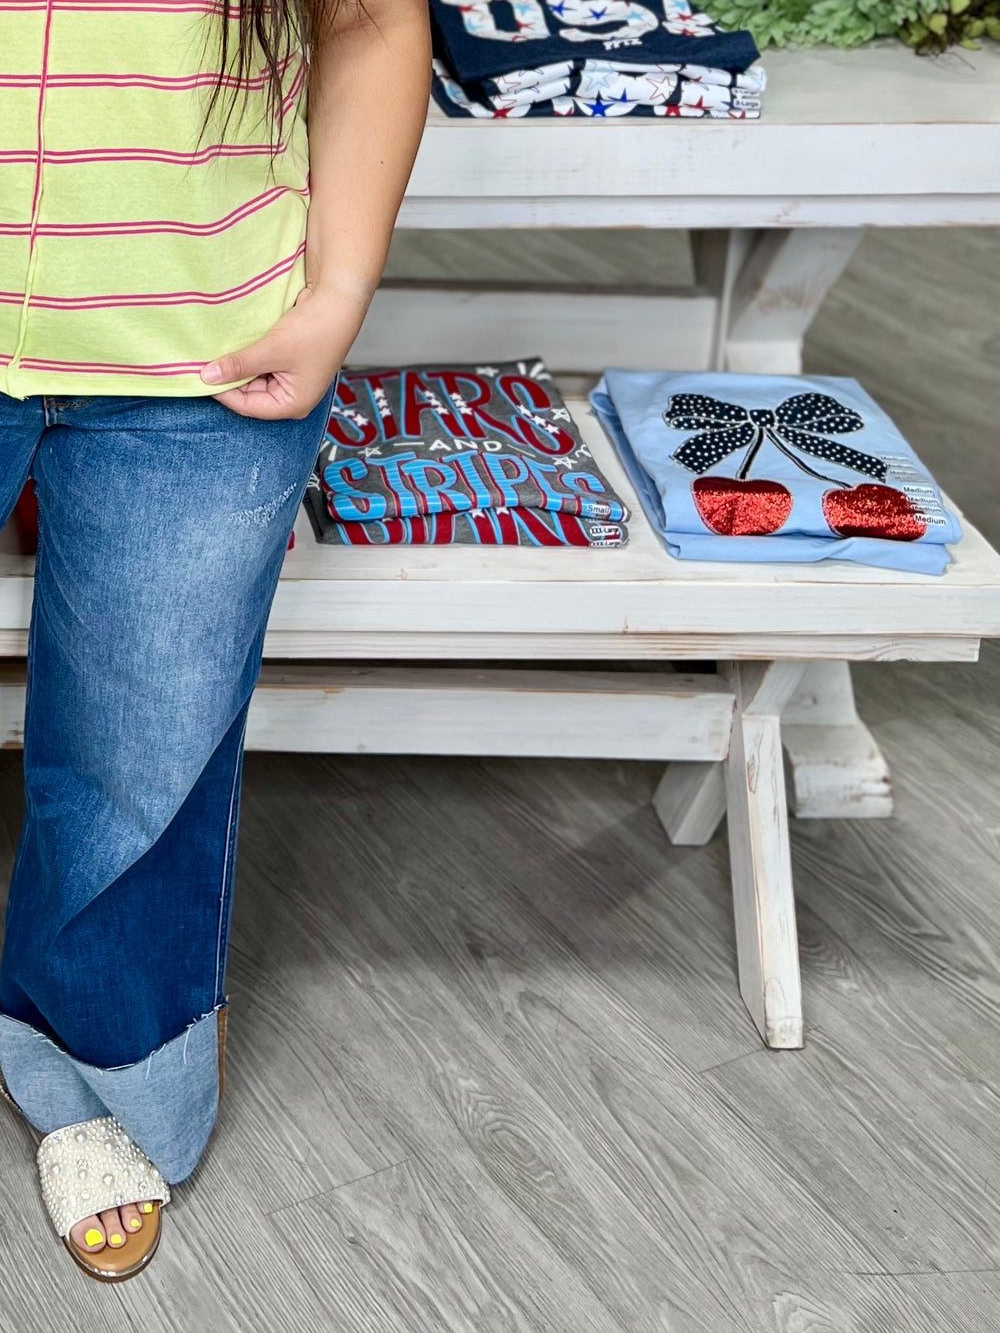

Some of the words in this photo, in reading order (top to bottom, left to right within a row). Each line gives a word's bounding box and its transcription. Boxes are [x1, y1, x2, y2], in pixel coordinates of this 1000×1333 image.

[325, 370, 576, 457] STARS
[429, 439, 502, 452] AND
[322, 450, 627, 523] STRIPES
[588, 505, 610, 515] Small
[914, 514, 947, 526] Medium
